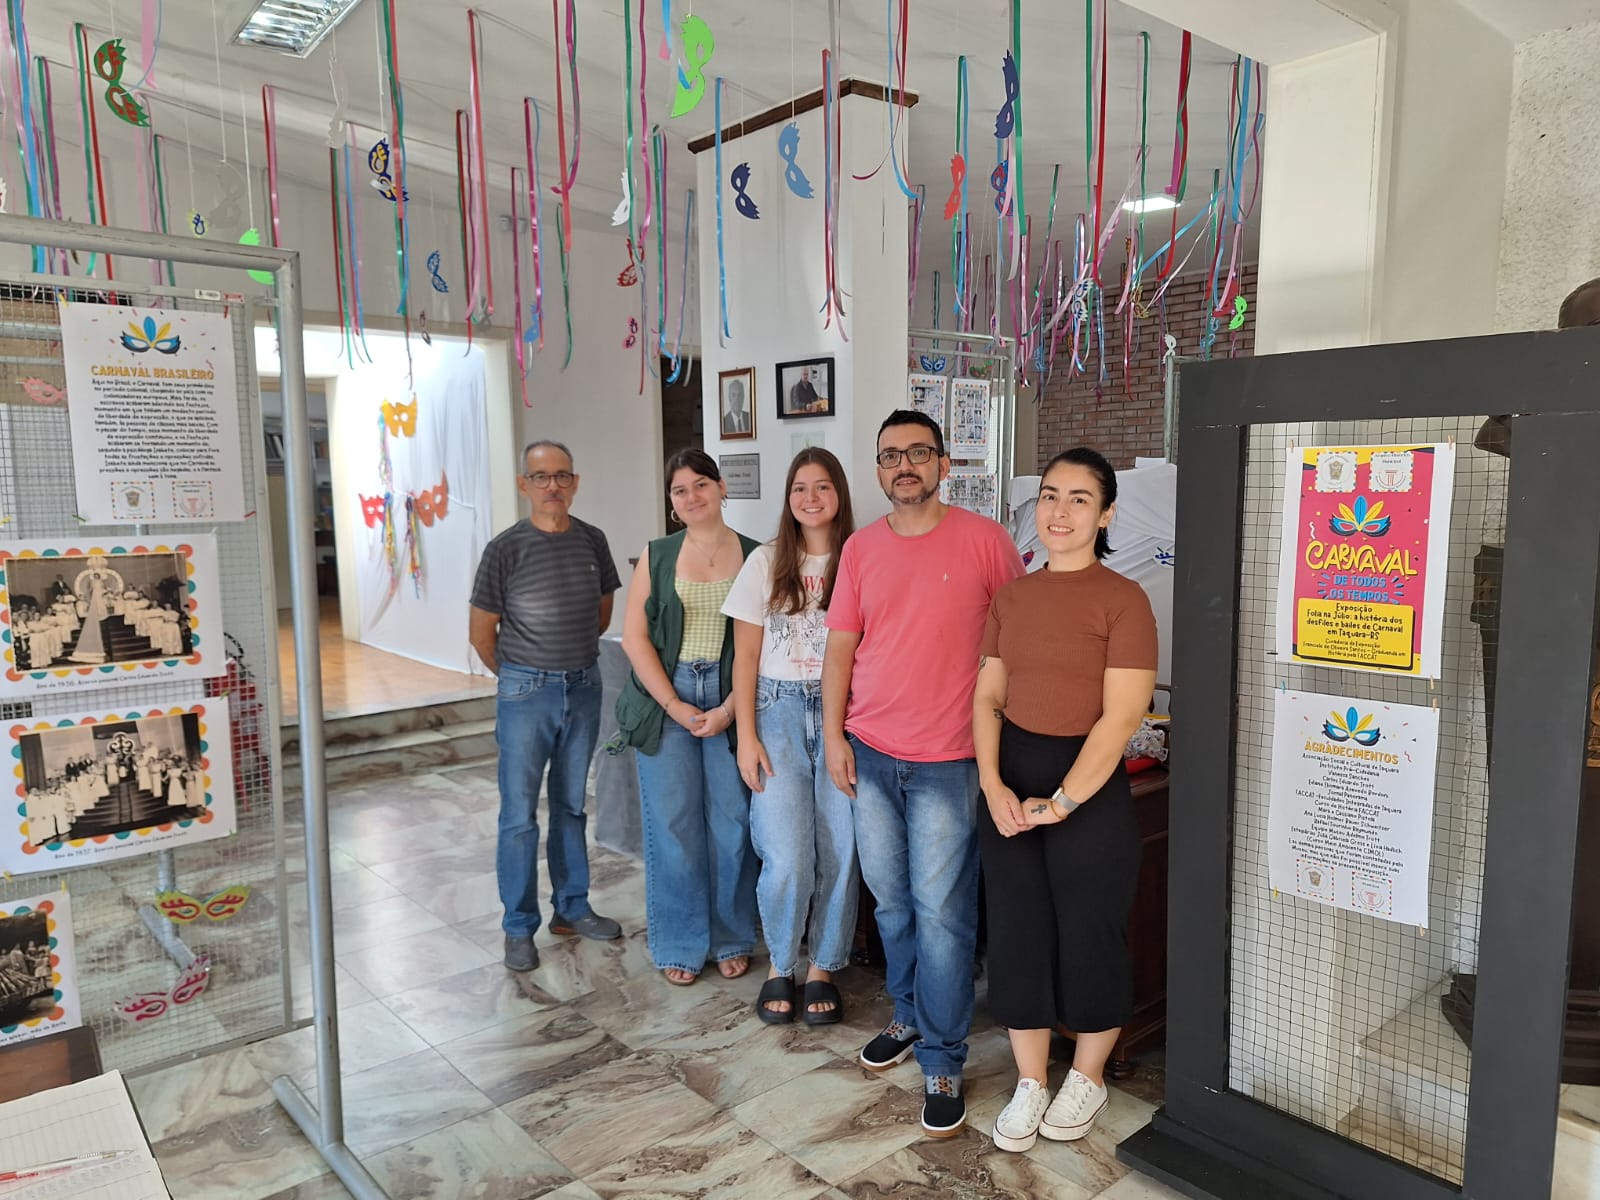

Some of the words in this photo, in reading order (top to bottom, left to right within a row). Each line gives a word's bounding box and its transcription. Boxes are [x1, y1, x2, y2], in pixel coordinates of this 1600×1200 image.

[92, 366, 150, 378] CARNAVAL
[154, 368, 214, 380] BRASILEIRO
[1306, 540, 1418, 576] CARNAVAL
[1334, 575, 1348, 586] DE
[1351, 576, 1387, 588] TODOS
[1330, 588, 1344, 599] OS
[1347, 590, 1390, 603] TEMPOS
[1337, 602, 1372, 614] Exposição
[1307, 608, 1322, 617] Folia
[1360, 613, 1388, 623] história
[1389, 616, 1403, 624] dos
[1307, 617, 1333, 627] desfiles
[1341, 620, 1360, 629] bailes
[1362, 622, 1371, 630] de
[1372, 623, 1403, 633] Carnaval
[1304, 741, 1398, 765] AGRADECIMENTOS
